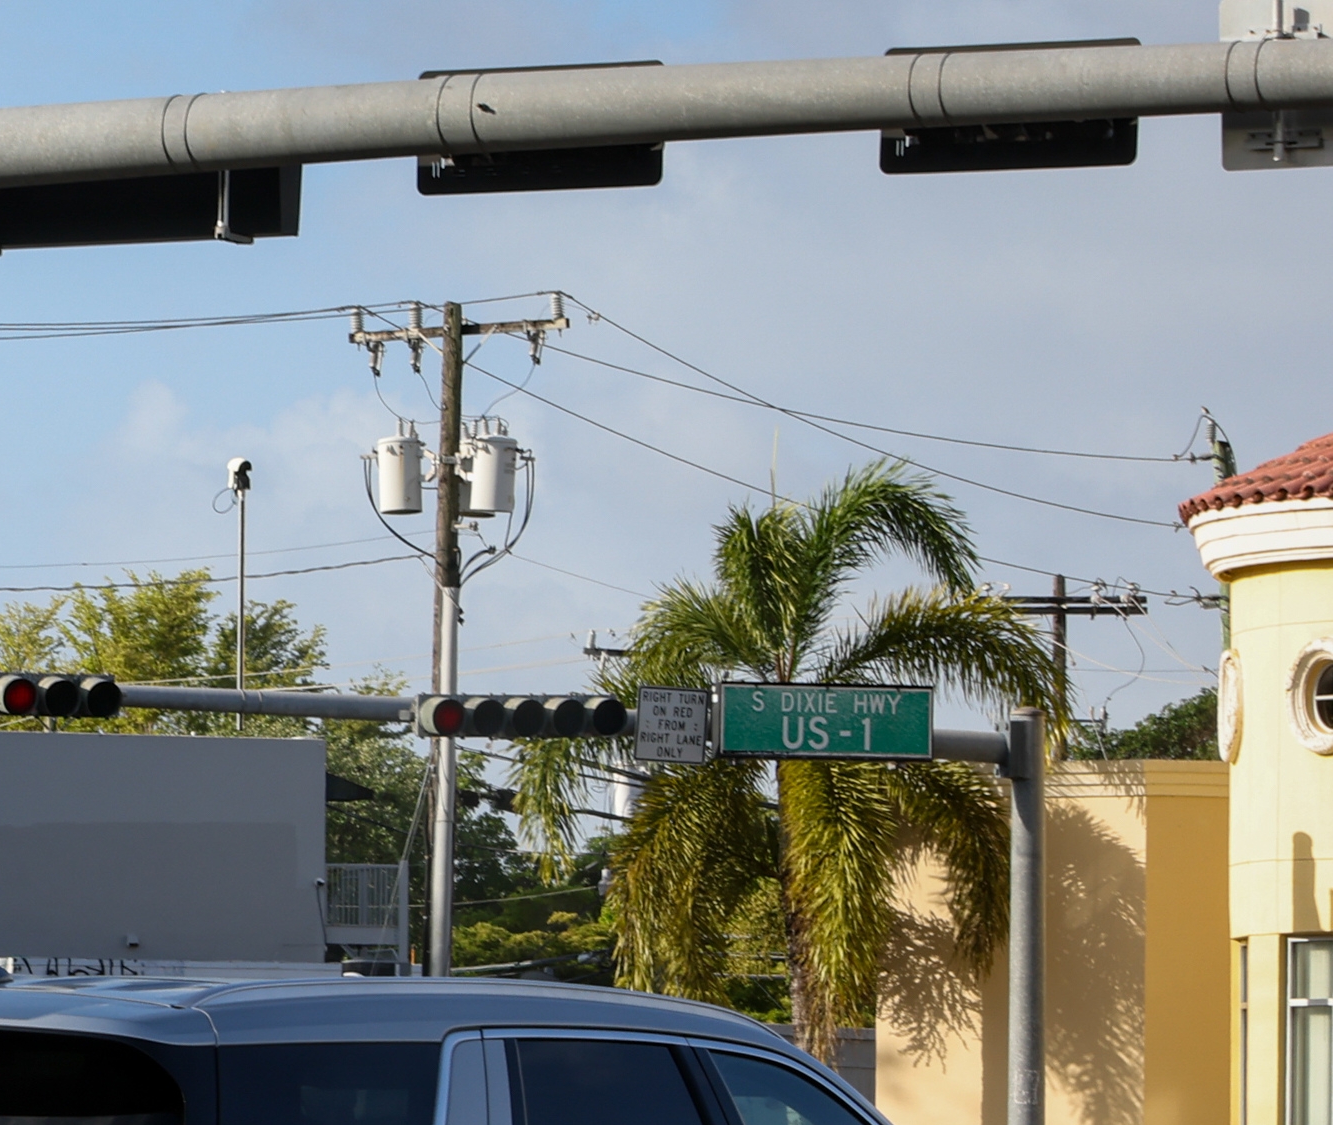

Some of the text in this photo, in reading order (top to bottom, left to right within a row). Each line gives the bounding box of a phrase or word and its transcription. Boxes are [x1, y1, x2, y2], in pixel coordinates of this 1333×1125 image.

[642, 690, 705, 706] RIGHT TURN
[751, 690, 902, 715] S DIXIE HWY
[652, 705, 693, 719] ON RED
[657, 718, 686, 732] FROM
[640, 731, 702, 747] RIGHT LANE
[656, 746, 683, 759] ONLY
